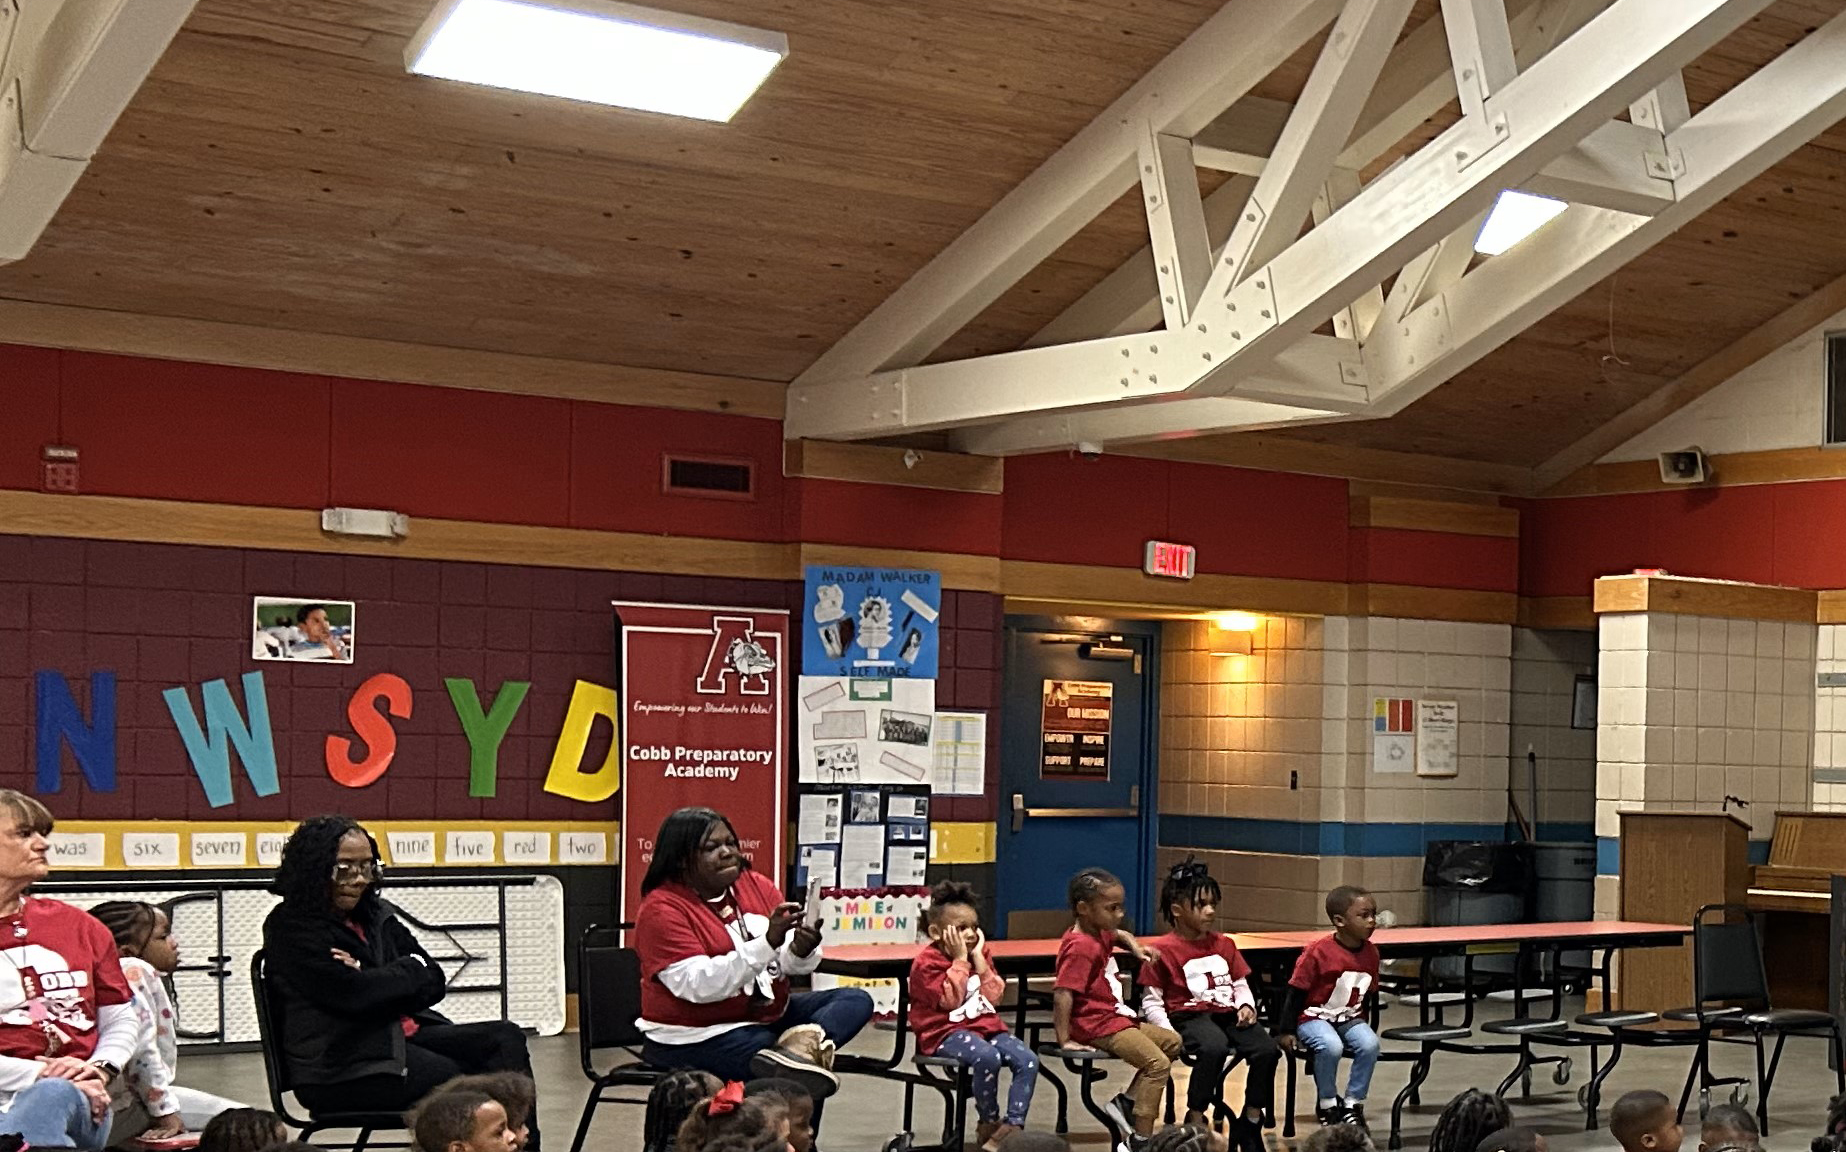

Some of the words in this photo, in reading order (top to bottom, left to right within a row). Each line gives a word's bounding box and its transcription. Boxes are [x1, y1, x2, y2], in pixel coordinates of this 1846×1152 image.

[1154, 543, 1188, 577] EXIT
[822, 571, 874, 583] MADAM
[881, 571, 931, 584] WALKER
[877, 666, 911, 677] MADE
[630, 745, 671, 760] Cobb
[675, 746, 773, 765] Preparatory
[664, 763, 740, 781] Academy
[133, 843, 161, 855] six
[195, 841, 241, 856] seven
[396, 838, 429, 853] nine
[455, 837, 484, 856] five
[514, 837, 536, 853] red
[568, 837, 596, 855] two
